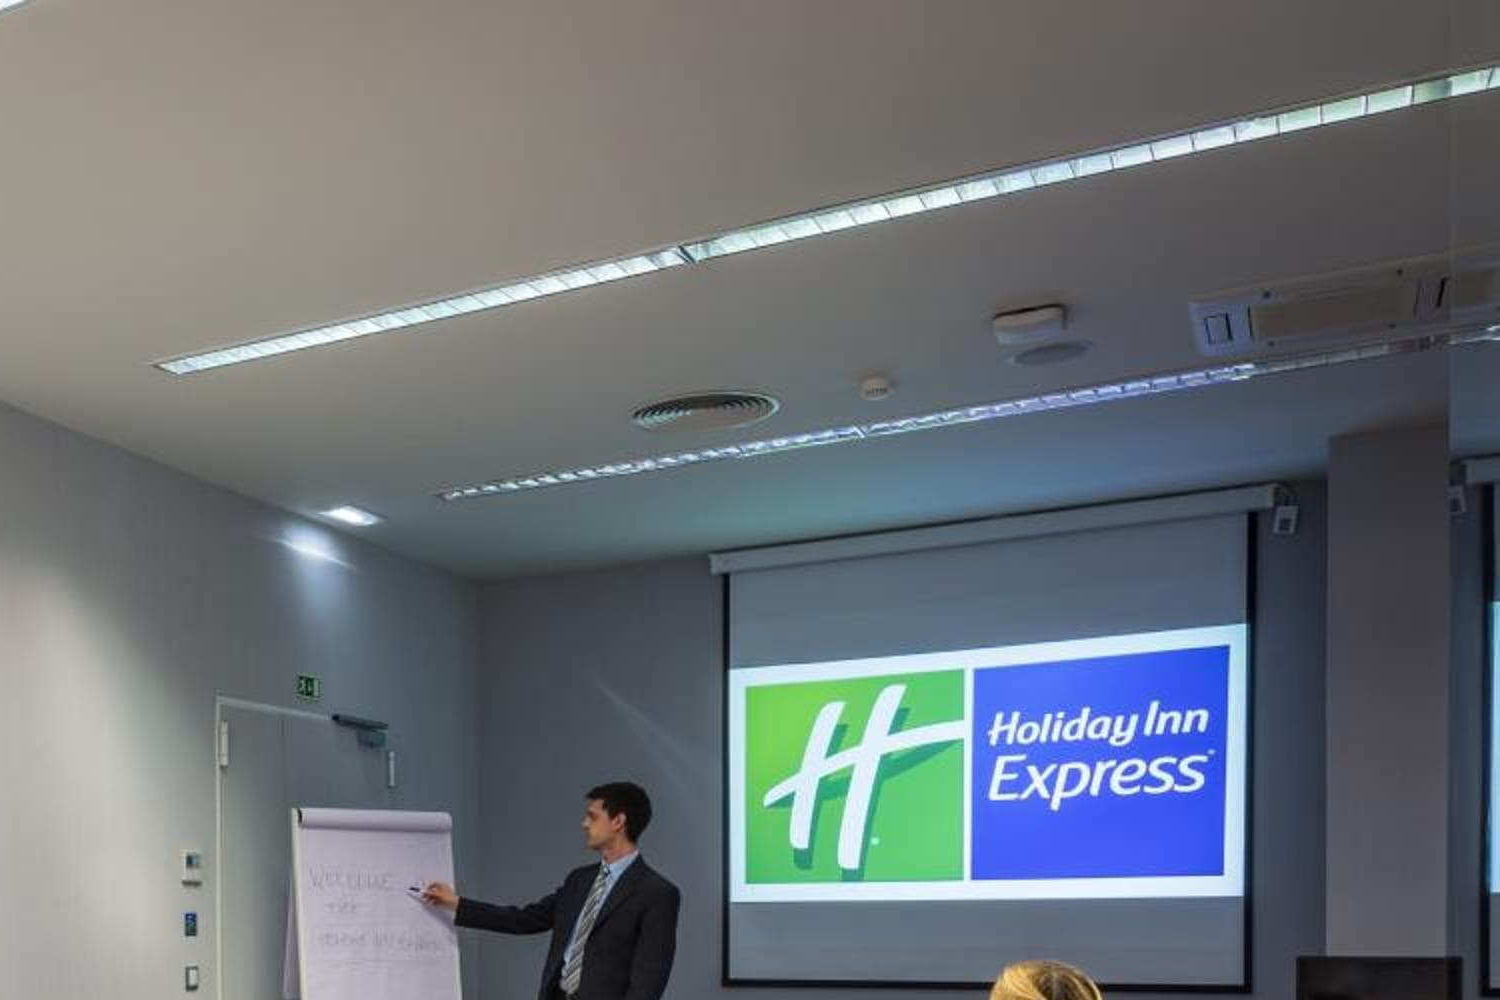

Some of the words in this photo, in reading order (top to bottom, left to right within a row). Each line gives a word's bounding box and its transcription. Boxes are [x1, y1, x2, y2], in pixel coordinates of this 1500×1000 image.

[987, 706, 1138, 747] Holiday
[1143, 700, 1209, 735] Inn
[987, 753, 1209, 811] Express
